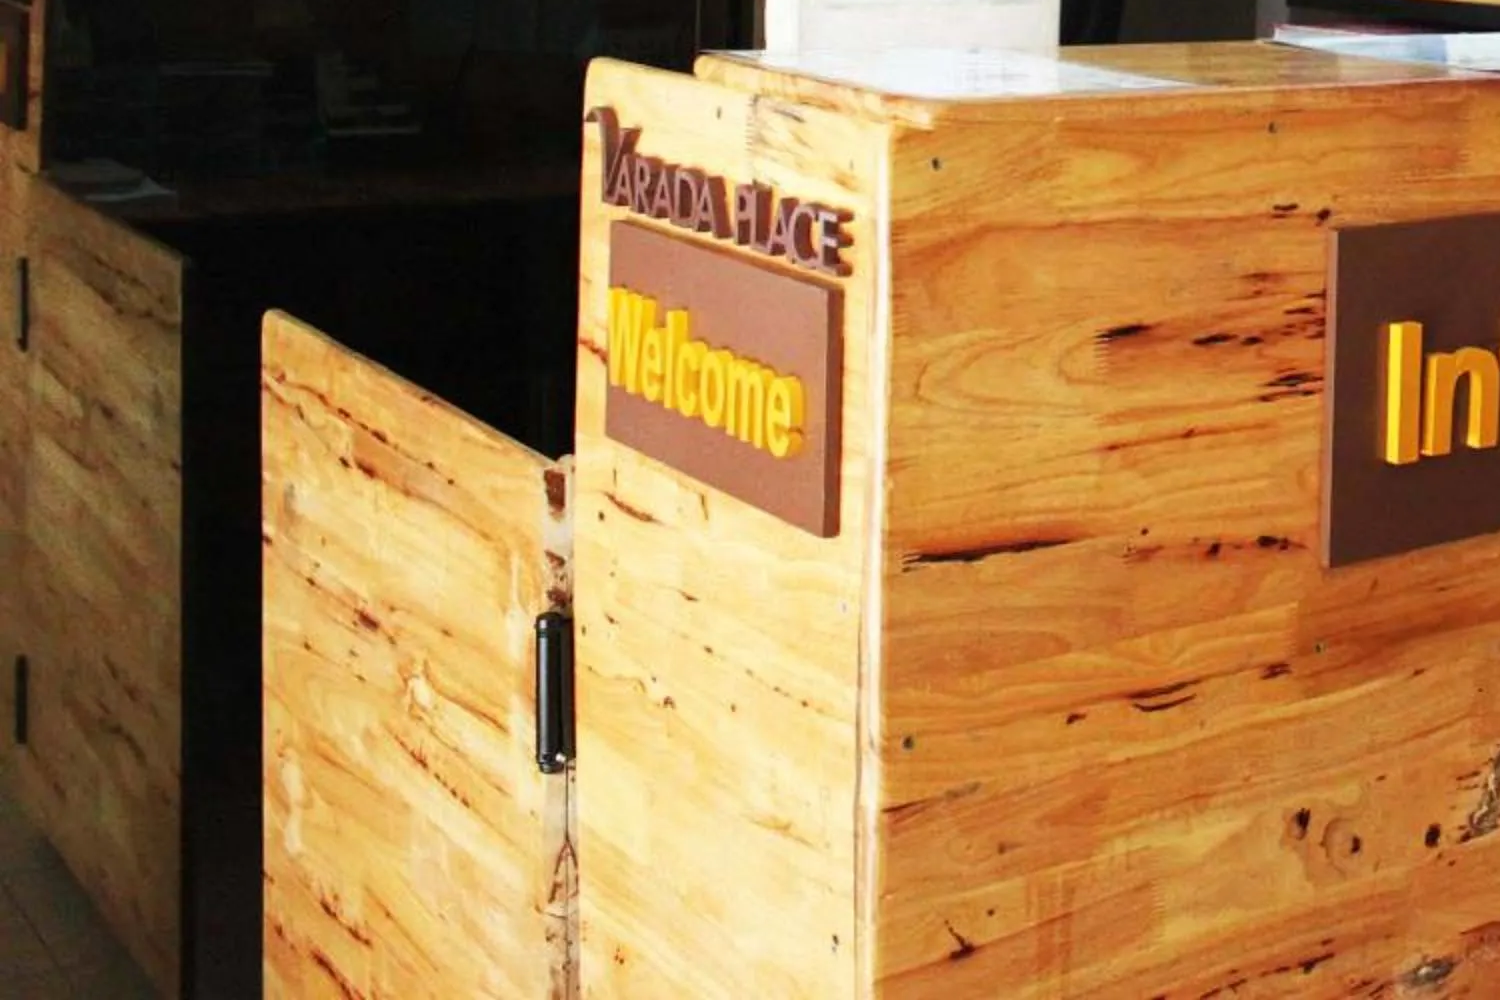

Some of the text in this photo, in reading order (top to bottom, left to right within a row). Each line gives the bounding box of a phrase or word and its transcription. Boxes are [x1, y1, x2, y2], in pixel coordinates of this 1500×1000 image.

[584, 105, 854, 277] VARADA PLACE
[607, 286, 803, 458] Welcome
